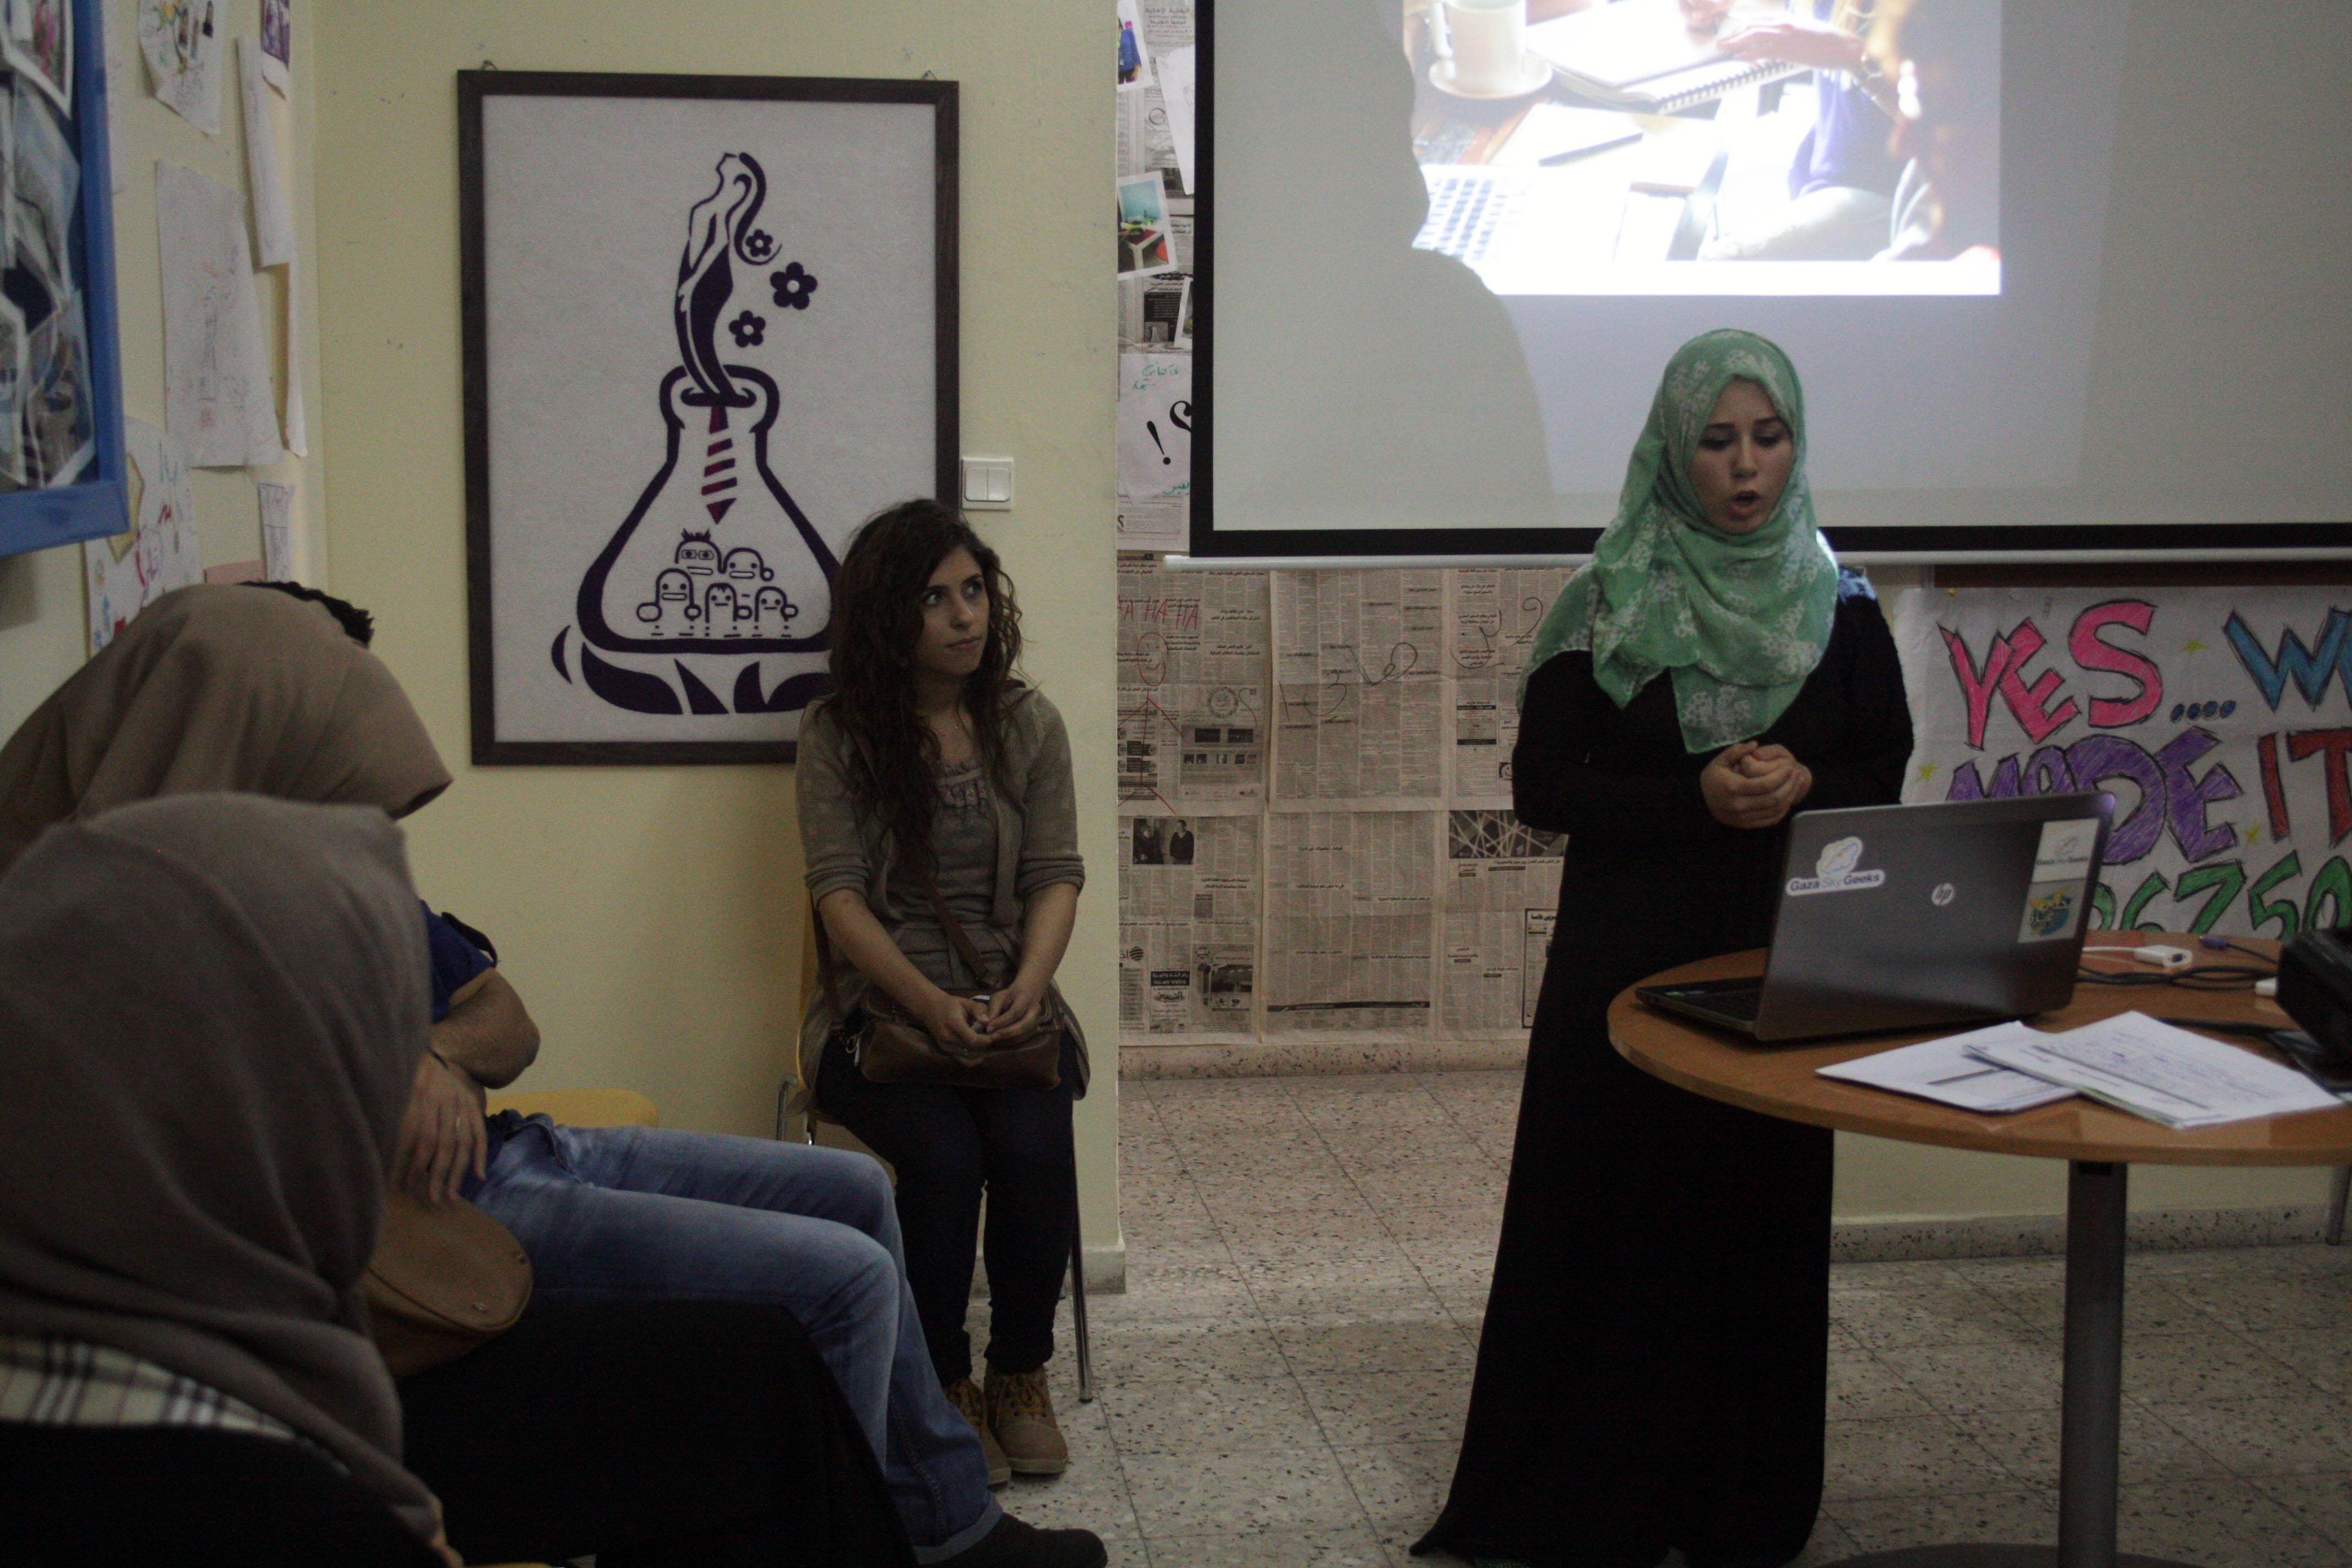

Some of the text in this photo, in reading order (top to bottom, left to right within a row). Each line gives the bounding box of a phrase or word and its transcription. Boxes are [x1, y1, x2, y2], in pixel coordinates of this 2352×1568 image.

[1145, 596, 1168, 624] HA
[1790, 873, 1880, 891] Gaza Sky Geeks
[1932, 883, 1954, 906] hp
